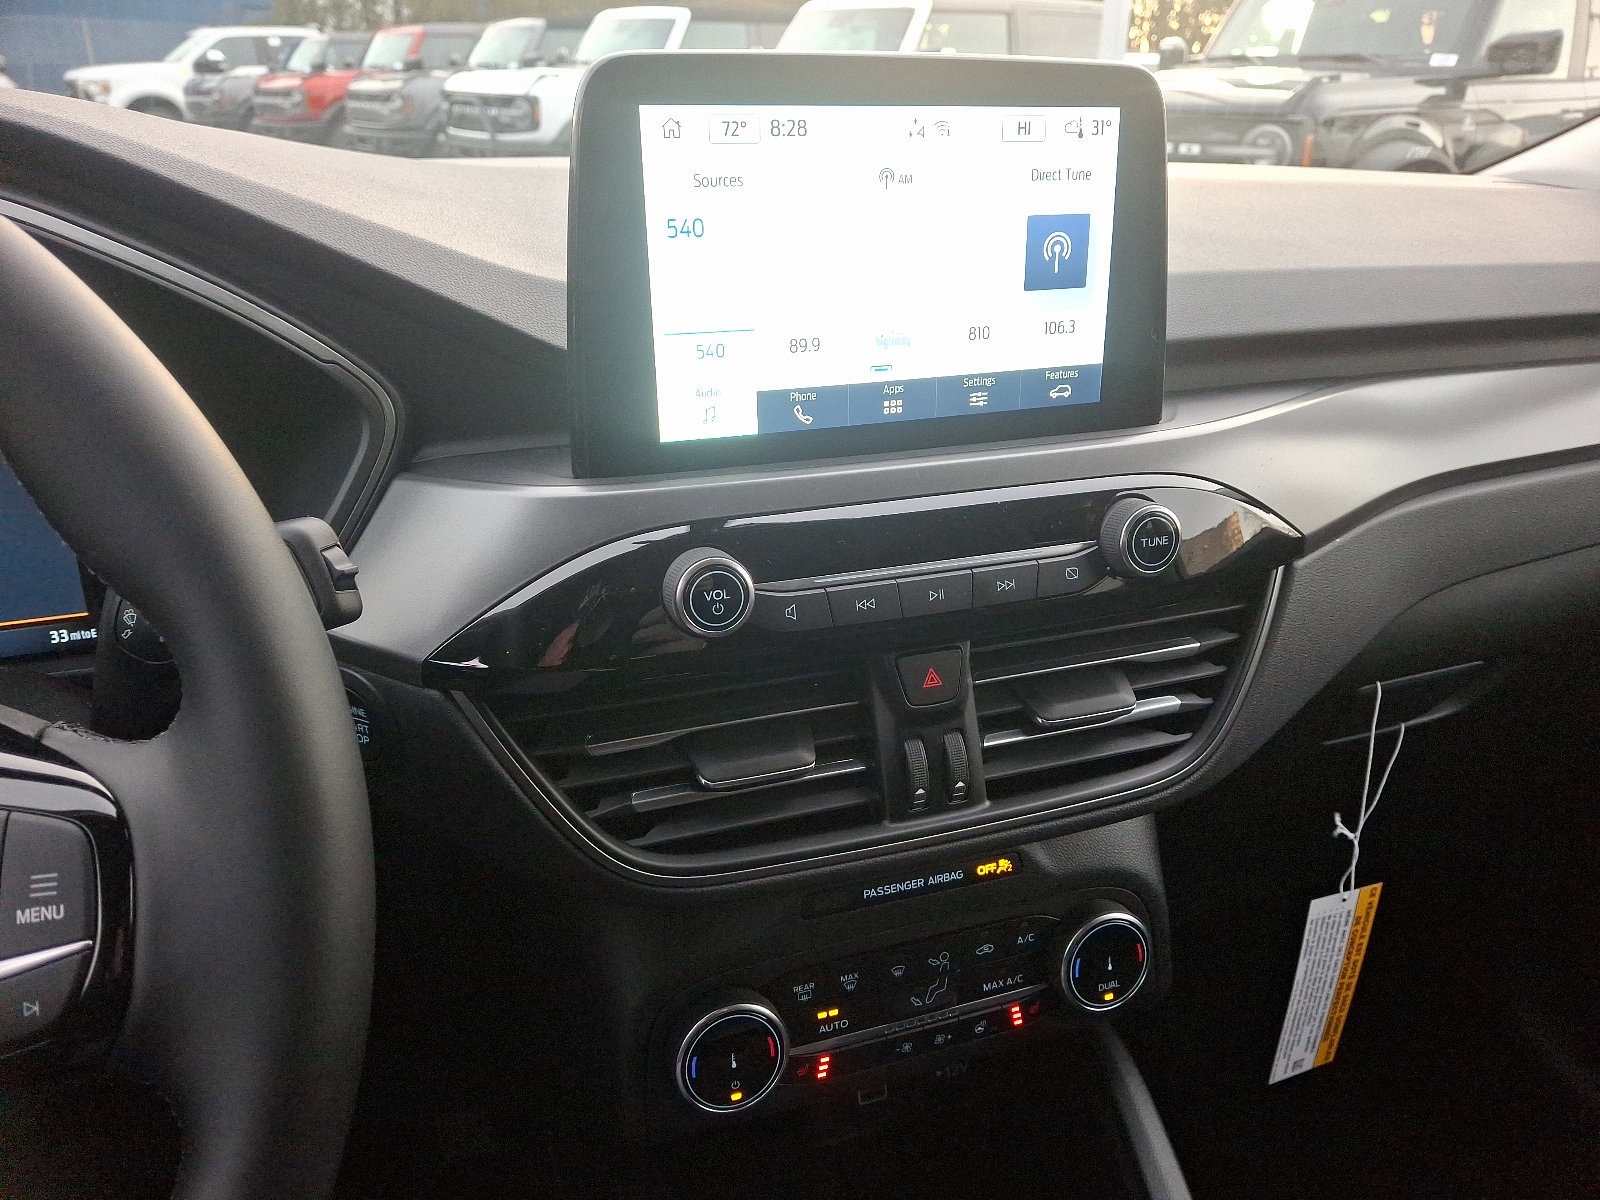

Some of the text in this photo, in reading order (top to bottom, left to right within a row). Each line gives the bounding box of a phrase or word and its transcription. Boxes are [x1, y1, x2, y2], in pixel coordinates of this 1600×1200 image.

[721, 120, 747, 137] 72°
[770, 119, 808, 137] 8:28
[1017, 121, 1032, 136] HI
[1091, 119, 1112, 136] 31°
[693, 173, 744, 188] Sources
[898, 174, 913, 185] AM
[1031, 167, 1092, 182] Direct Tune
[667, 217, 705, 239] 540
[968, 325, 990, 341] 810
[1044, 319, 1076, 335] 106.3
[696, 342, 725, 360] 540
[789, 337, 821, 354] 89.9
[1045, 367, 1079, 380] Features
[963, 375, 996, 389] Settings
[789, 391, 817, 403] Phone
[882, 384, 905, 397] Apps
[1140, 535, 1169, 548] TUNE
[703, 588, 731, 602] VOL
[49, 629, 70, 643] 33
[356, 733, 370, 744] OP
[976, 862, 997, 876] OFF
[863, 870, 964, 899] PASSENGER AIRBAG
[16, 904, 65, 925] MENU
[1016, 933, 1035, 945] A/C
[840, 972, 859, 983] MAX
[983, 974, 1025, 992] MAX A/C
[793, 983, 815, 994] REAR
[1098, 979, 1121, 992] DUAL
[818, 1019, 849, 1034] AUTO
